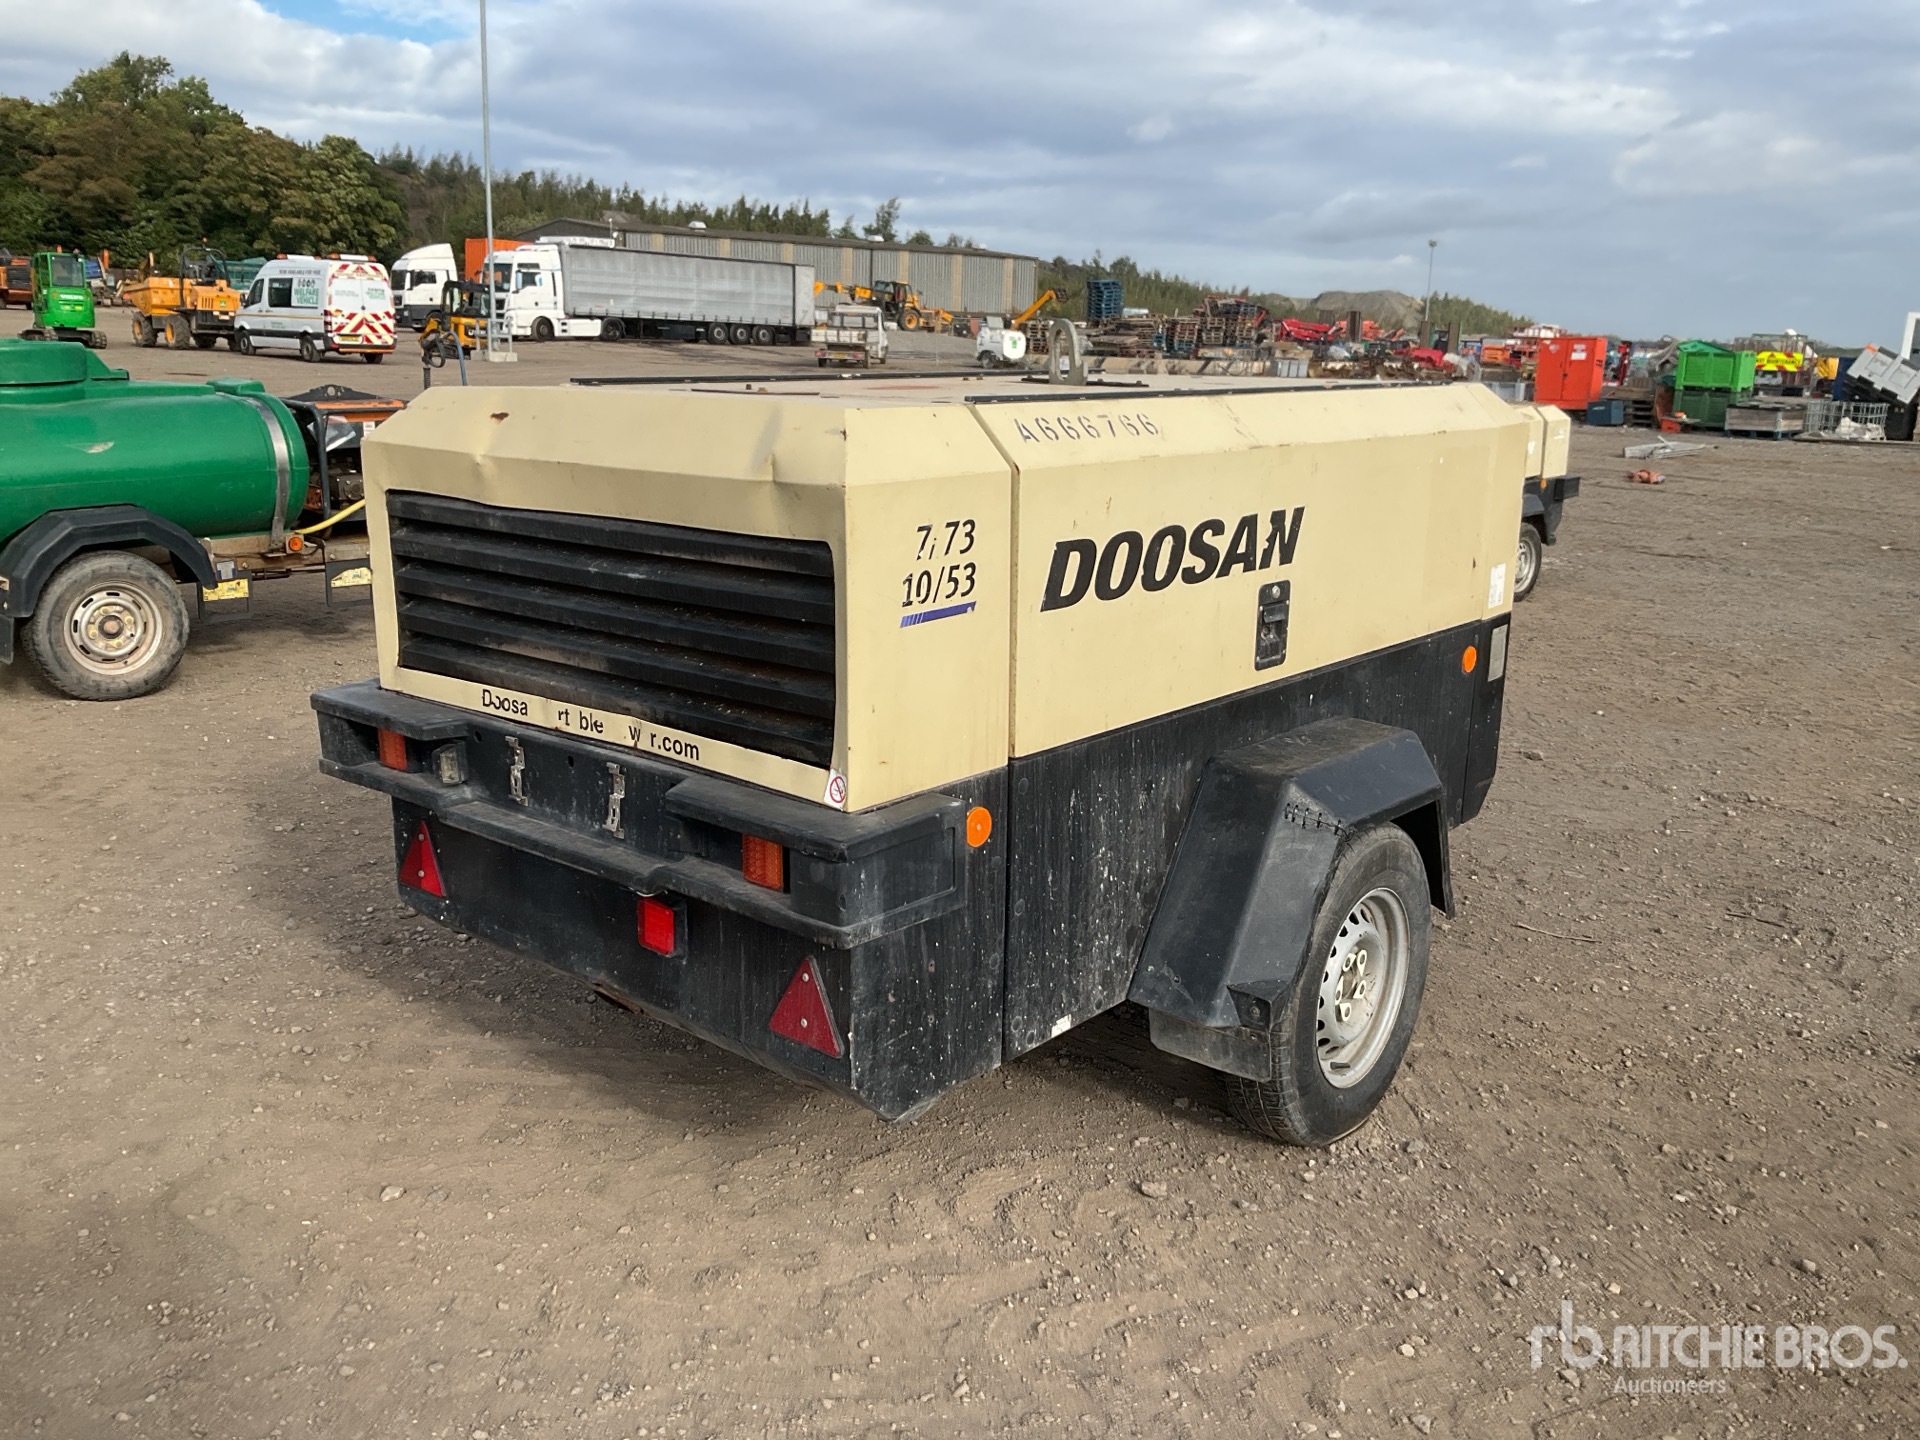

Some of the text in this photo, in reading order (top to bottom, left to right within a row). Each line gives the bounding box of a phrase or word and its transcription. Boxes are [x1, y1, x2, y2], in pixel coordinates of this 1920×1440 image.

[294, 288, 319, 296] WELFARE
[296, 296, 319, 305] VEHICLE
[1040, 506, 1306, 612] DOOSAN
[901, 562, 976, 607] 10/53
